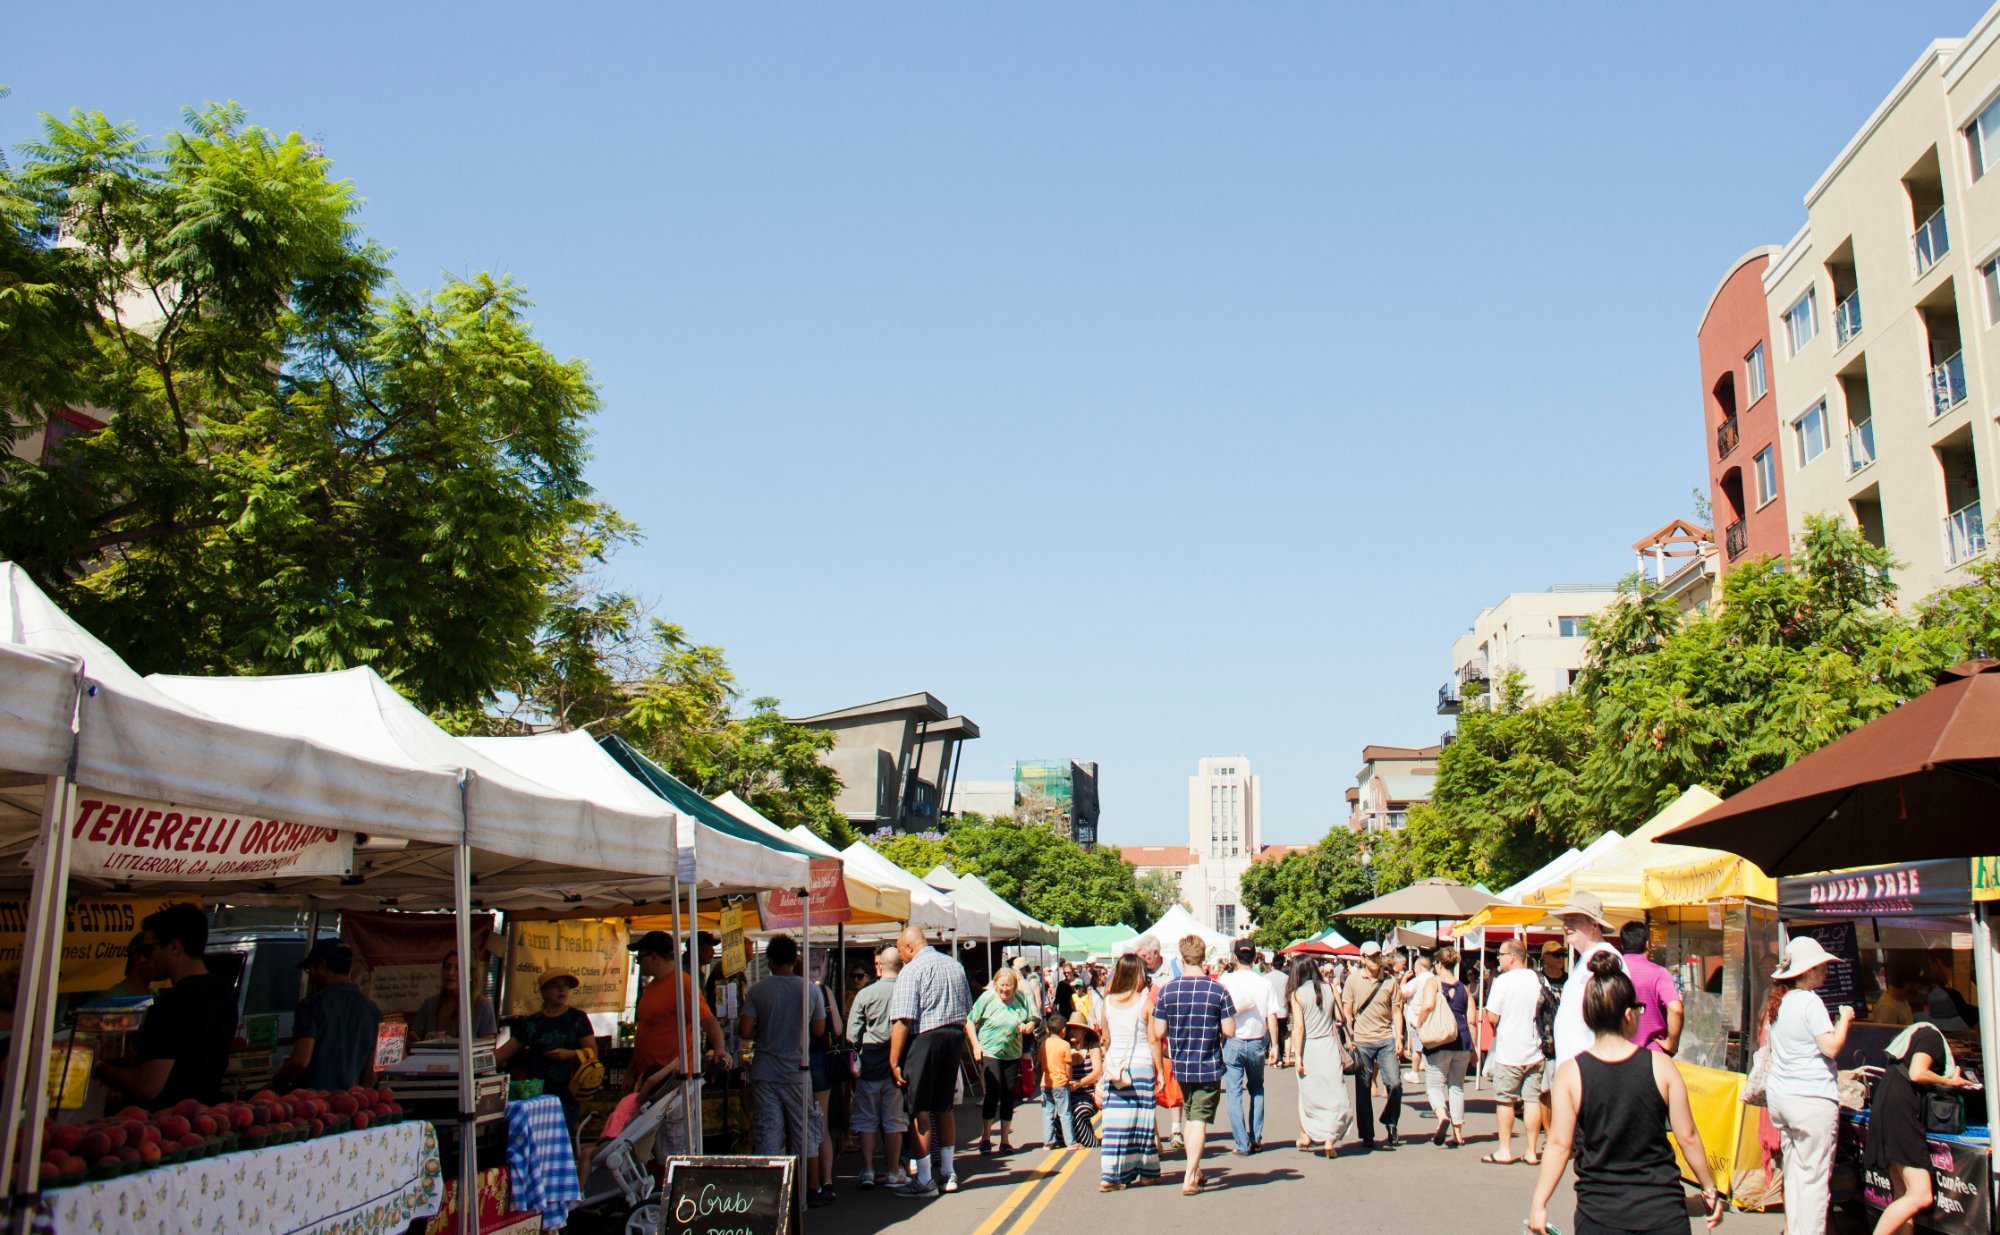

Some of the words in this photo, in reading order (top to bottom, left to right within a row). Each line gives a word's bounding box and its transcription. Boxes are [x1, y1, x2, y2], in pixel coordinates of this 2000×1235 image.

[72, 800, 241, 854] TENERELLI
[1809, 877, 1868, 904] GLUTEN
[1873, 868, 1920, 898] FREE
[66, 896, 135, 932] Farms
[61, 943, 92, 960] nest
[555, 922, 592, 953] Fresh
[1873, 1171, 1891, 1190] Free
[699, 1183, 754, 1215] Grab
[1937, 1190, 1965, 1213] Vegan
